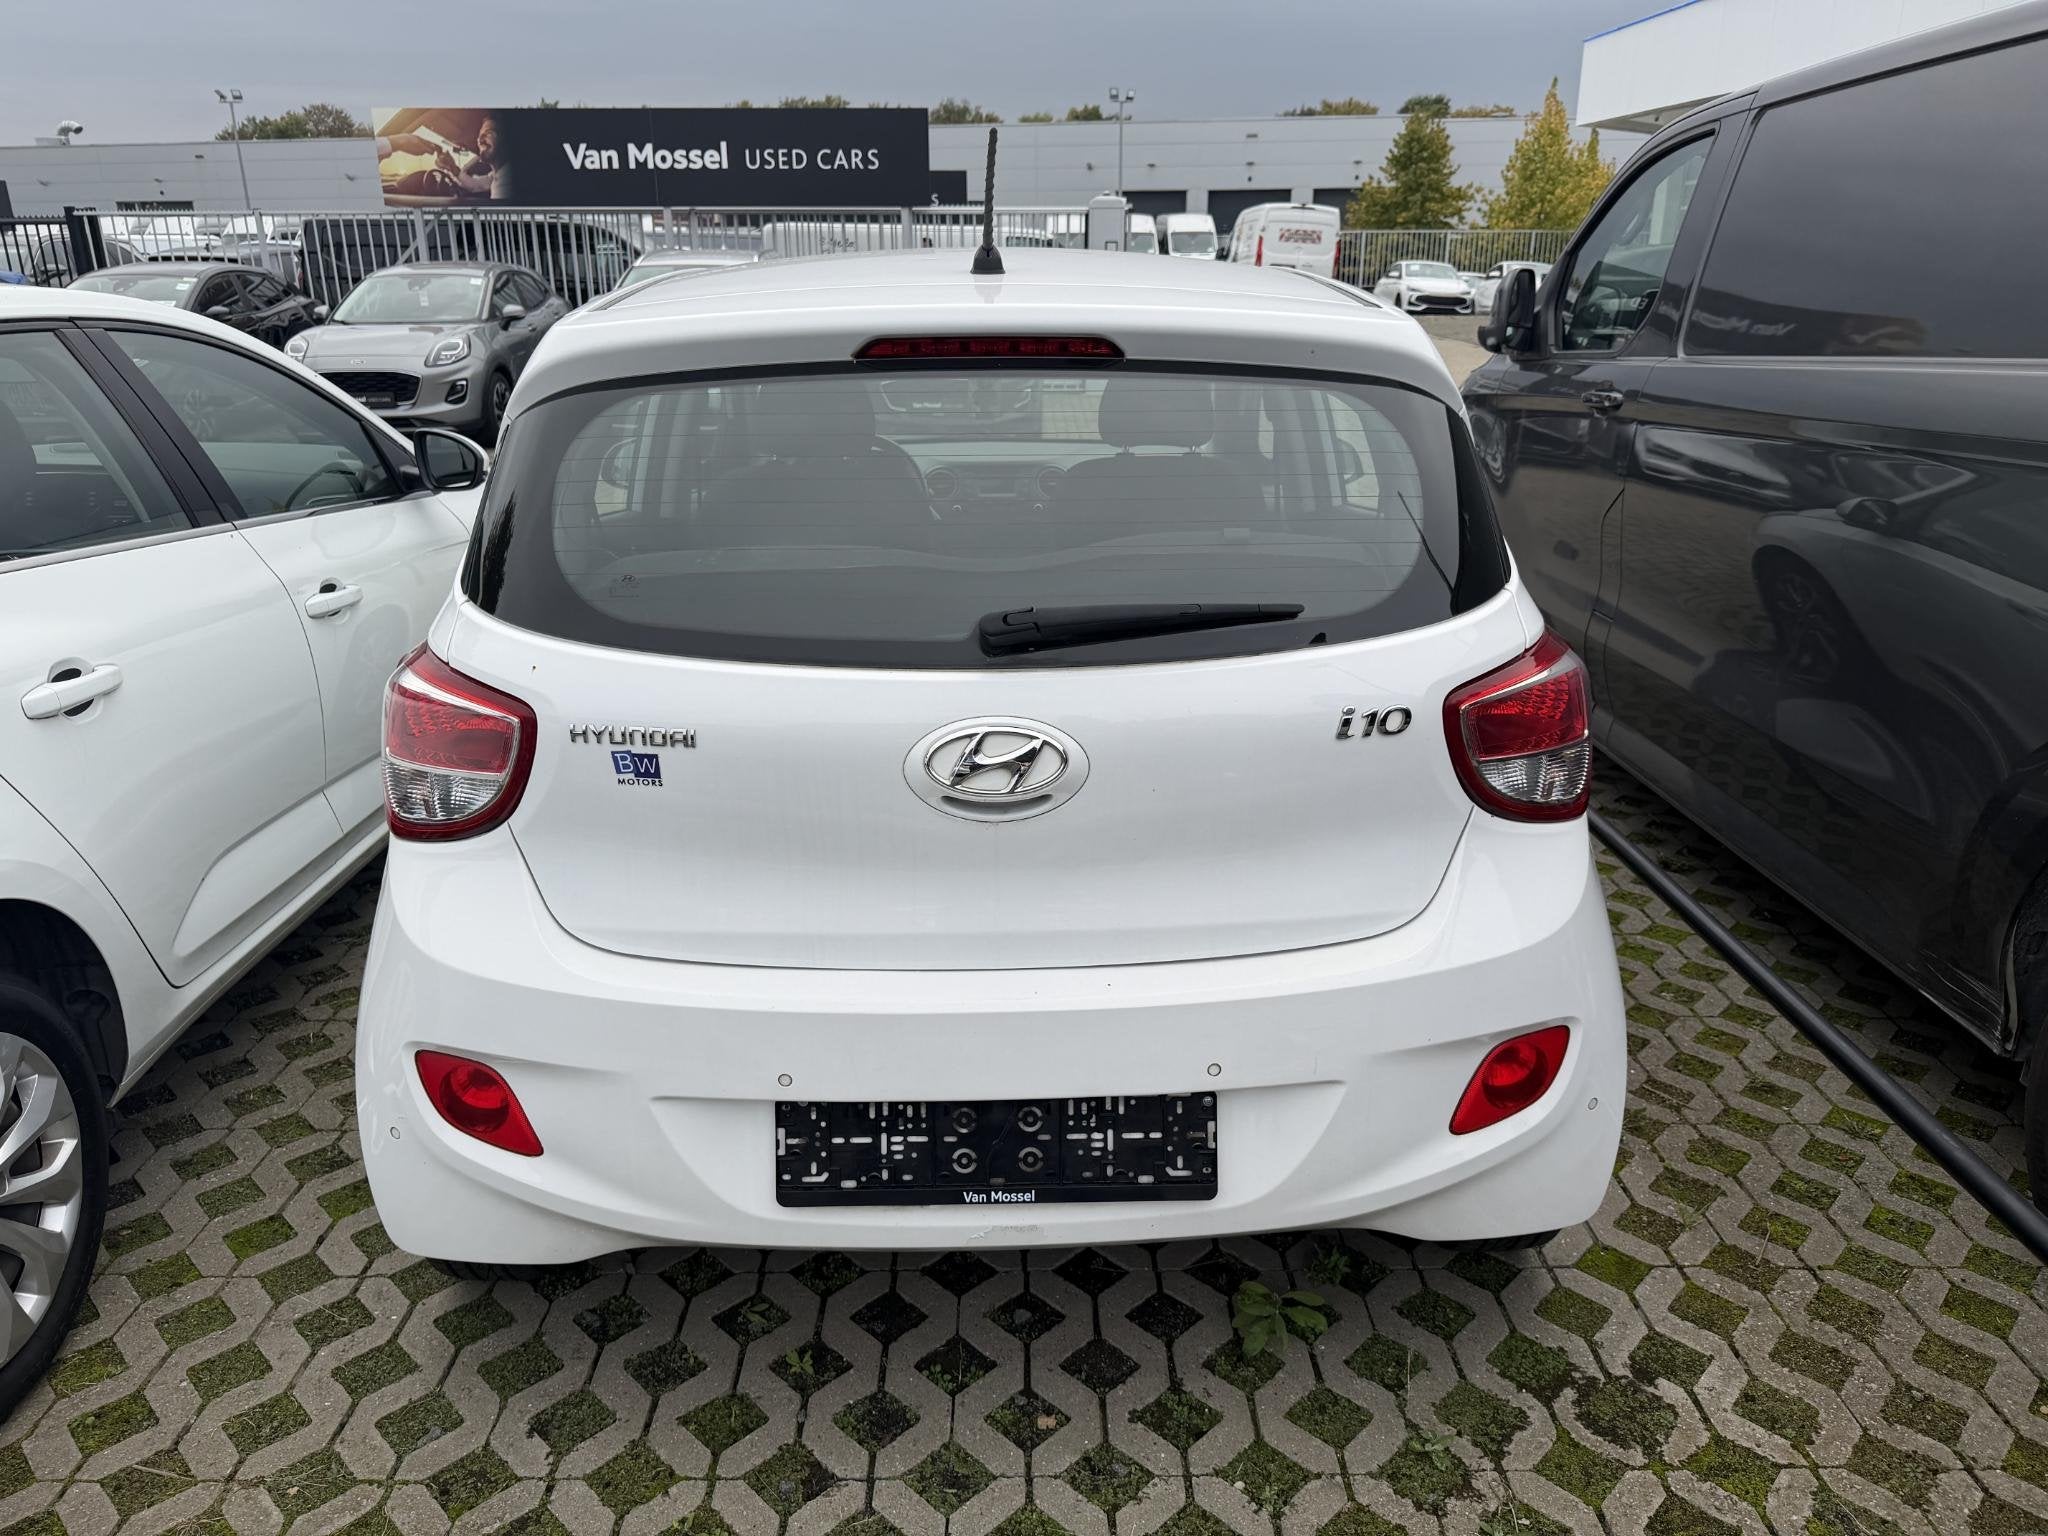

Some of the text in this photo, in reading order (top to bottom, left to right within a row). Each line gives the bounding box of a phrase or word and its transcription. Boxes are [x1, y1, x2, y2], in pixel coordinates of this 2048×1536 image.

[563, 140, 880, 170] Van Mossel USED CARS
[1336, 704, 1412, 740] i10
[569, 723, 697, 748] HYUNDAI
[613, 752, 657, 775] BW
[617, 778, 663, 787] MOTORS
[963, 1189, 1036, 1203] Van Mossel
